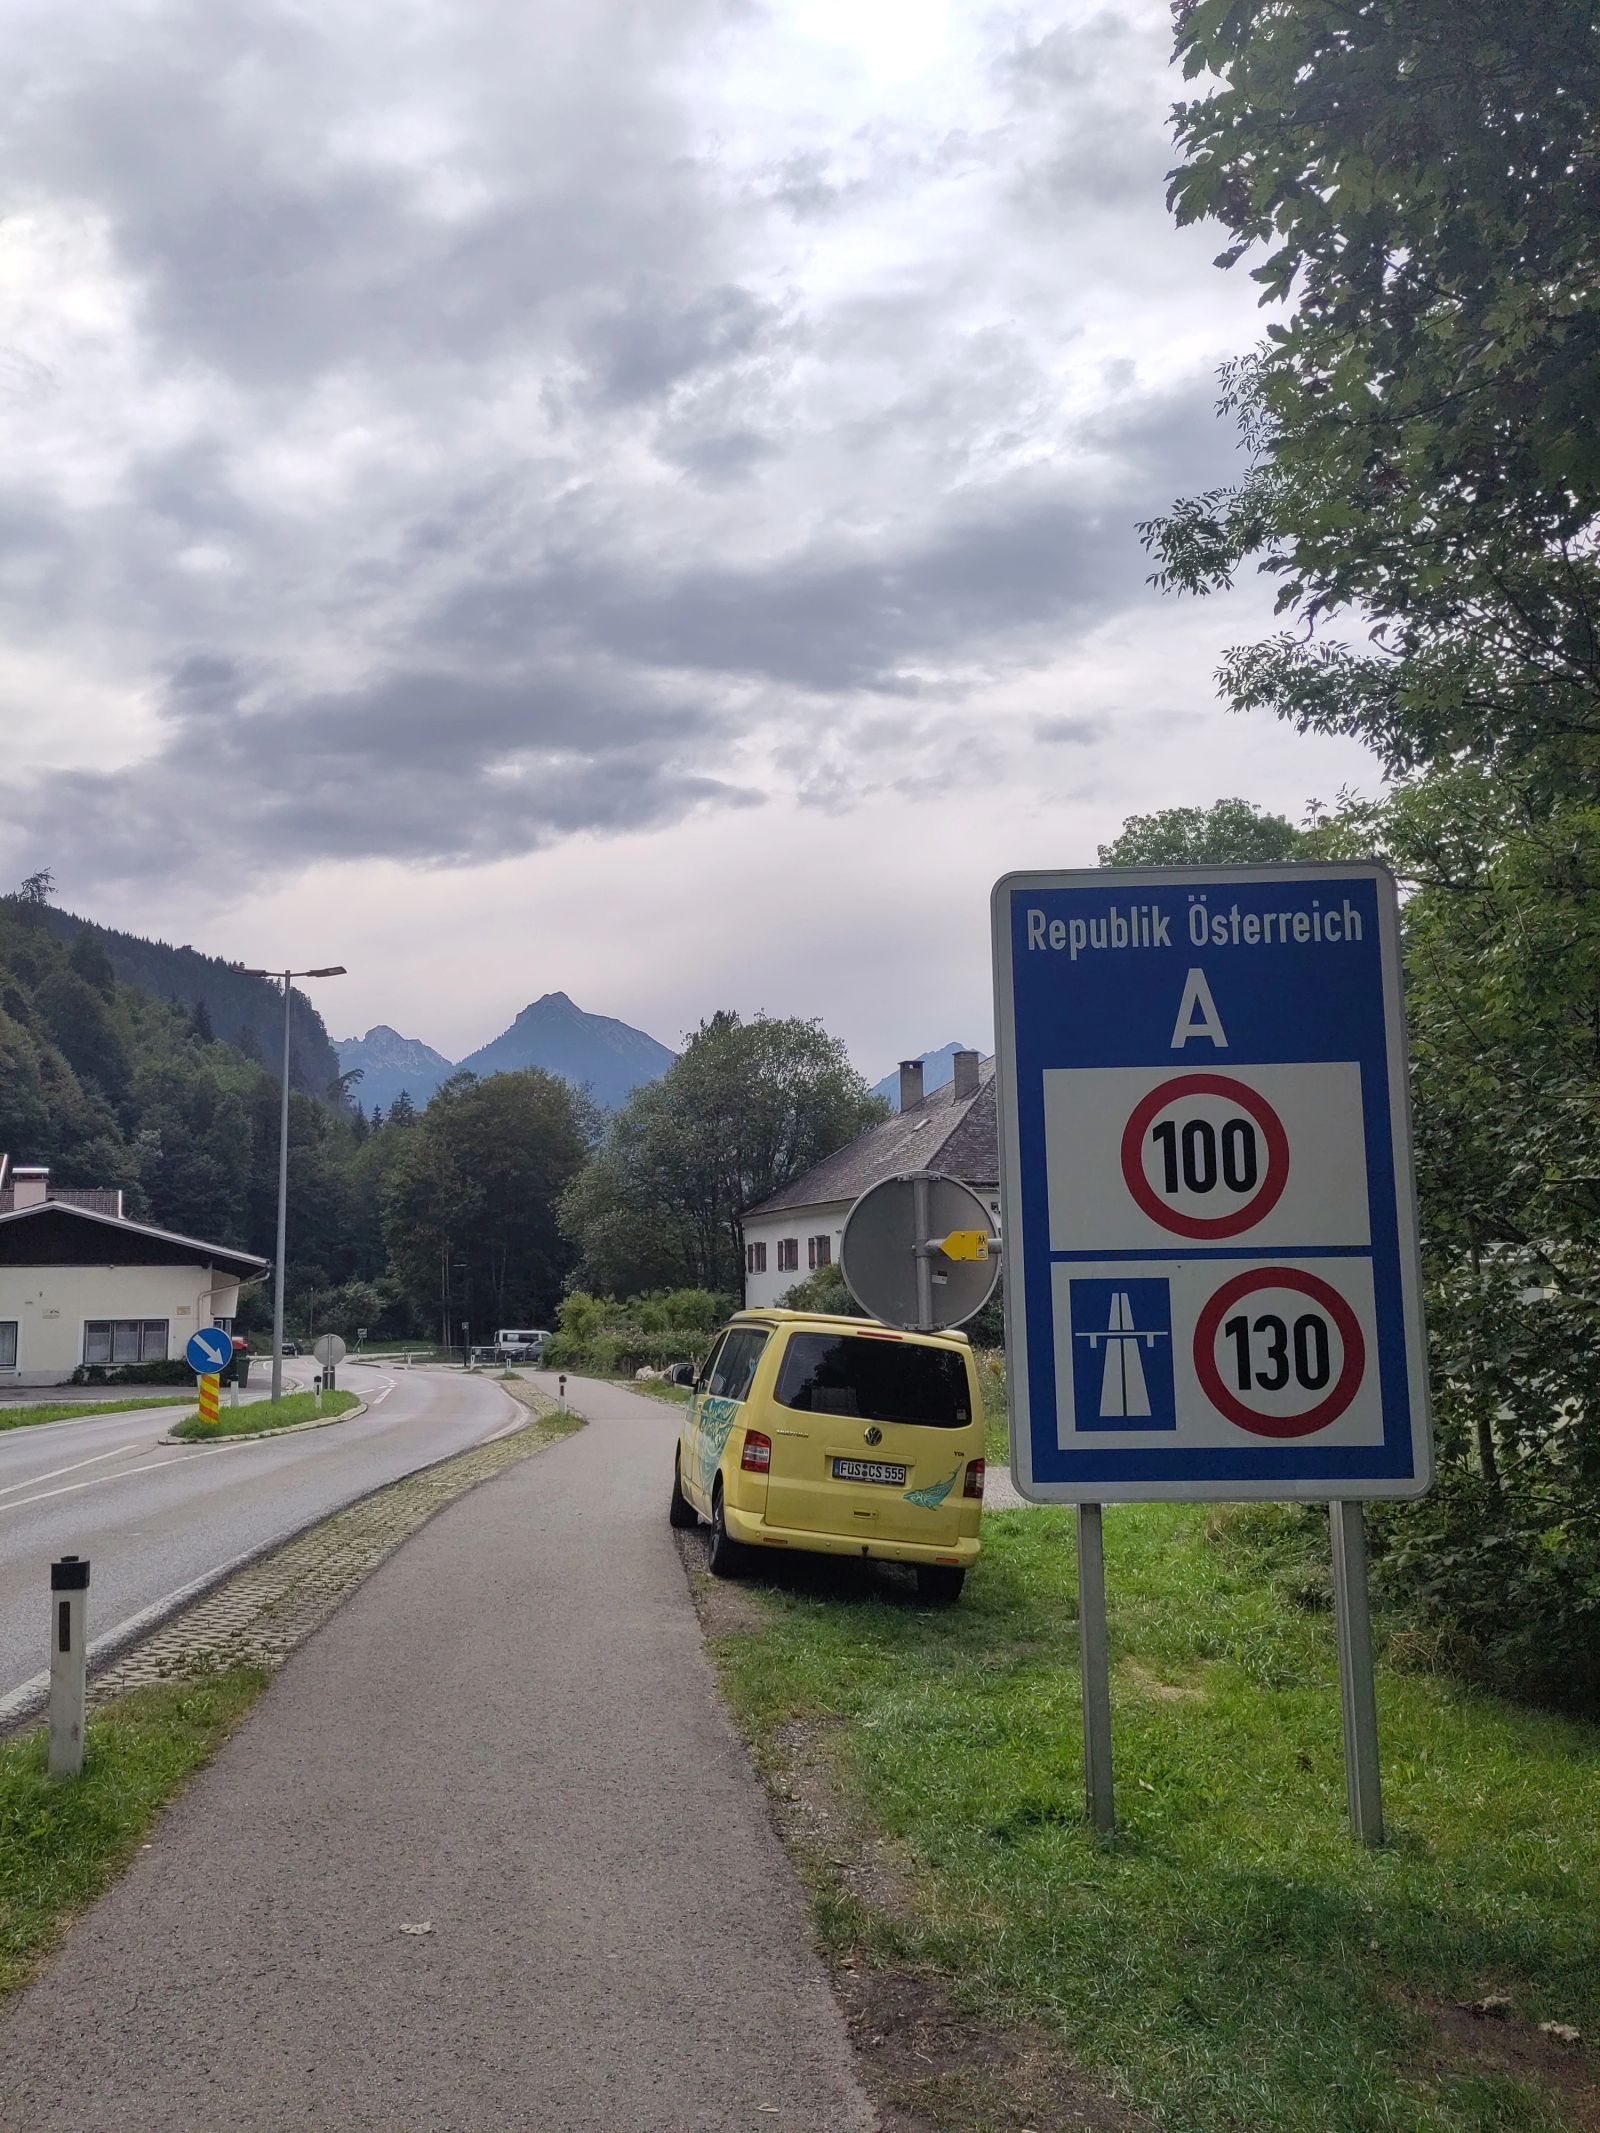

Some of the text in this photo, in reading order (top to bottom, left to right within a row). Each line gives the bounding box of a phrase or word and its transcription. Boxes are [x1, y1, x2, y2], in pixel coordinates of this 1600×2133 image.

[1027, 894, 1362, 960] Republik Österreich
[1170, 967, 1229, 1048] A
[1152, 1118, 1258, 1194] 100
[1224, 1313, 1330, 1391] 130
[840, 1462, 861, 1475] FÜS
[868, 1465, 882, 1478] CS
[884, 1467, 904, 1480] 555
